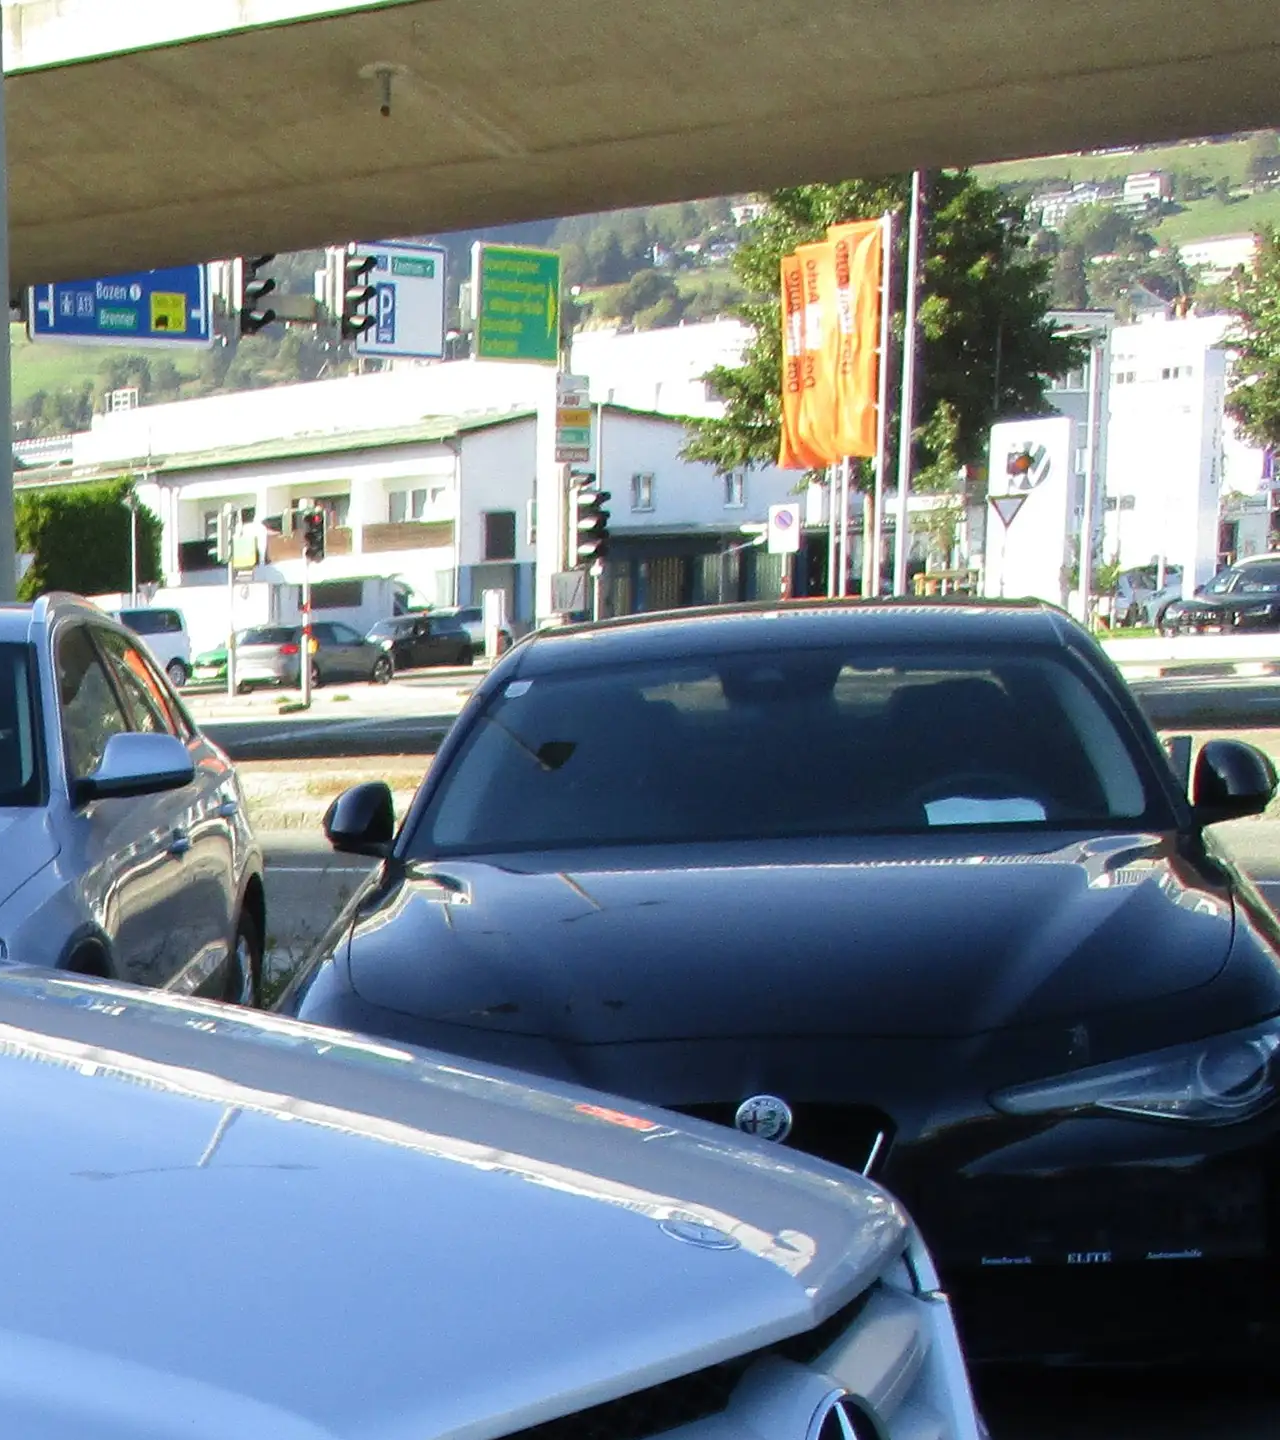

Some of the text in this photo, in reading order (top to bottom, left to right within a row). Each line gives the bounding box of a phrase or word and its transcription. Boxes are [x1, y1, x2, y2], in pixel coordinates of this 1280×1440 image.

[96, 281, 127, 300] Bozen
[100, 309, 135, 326] Brenner
[1066, 1251, 1113, 1265] ELITE
